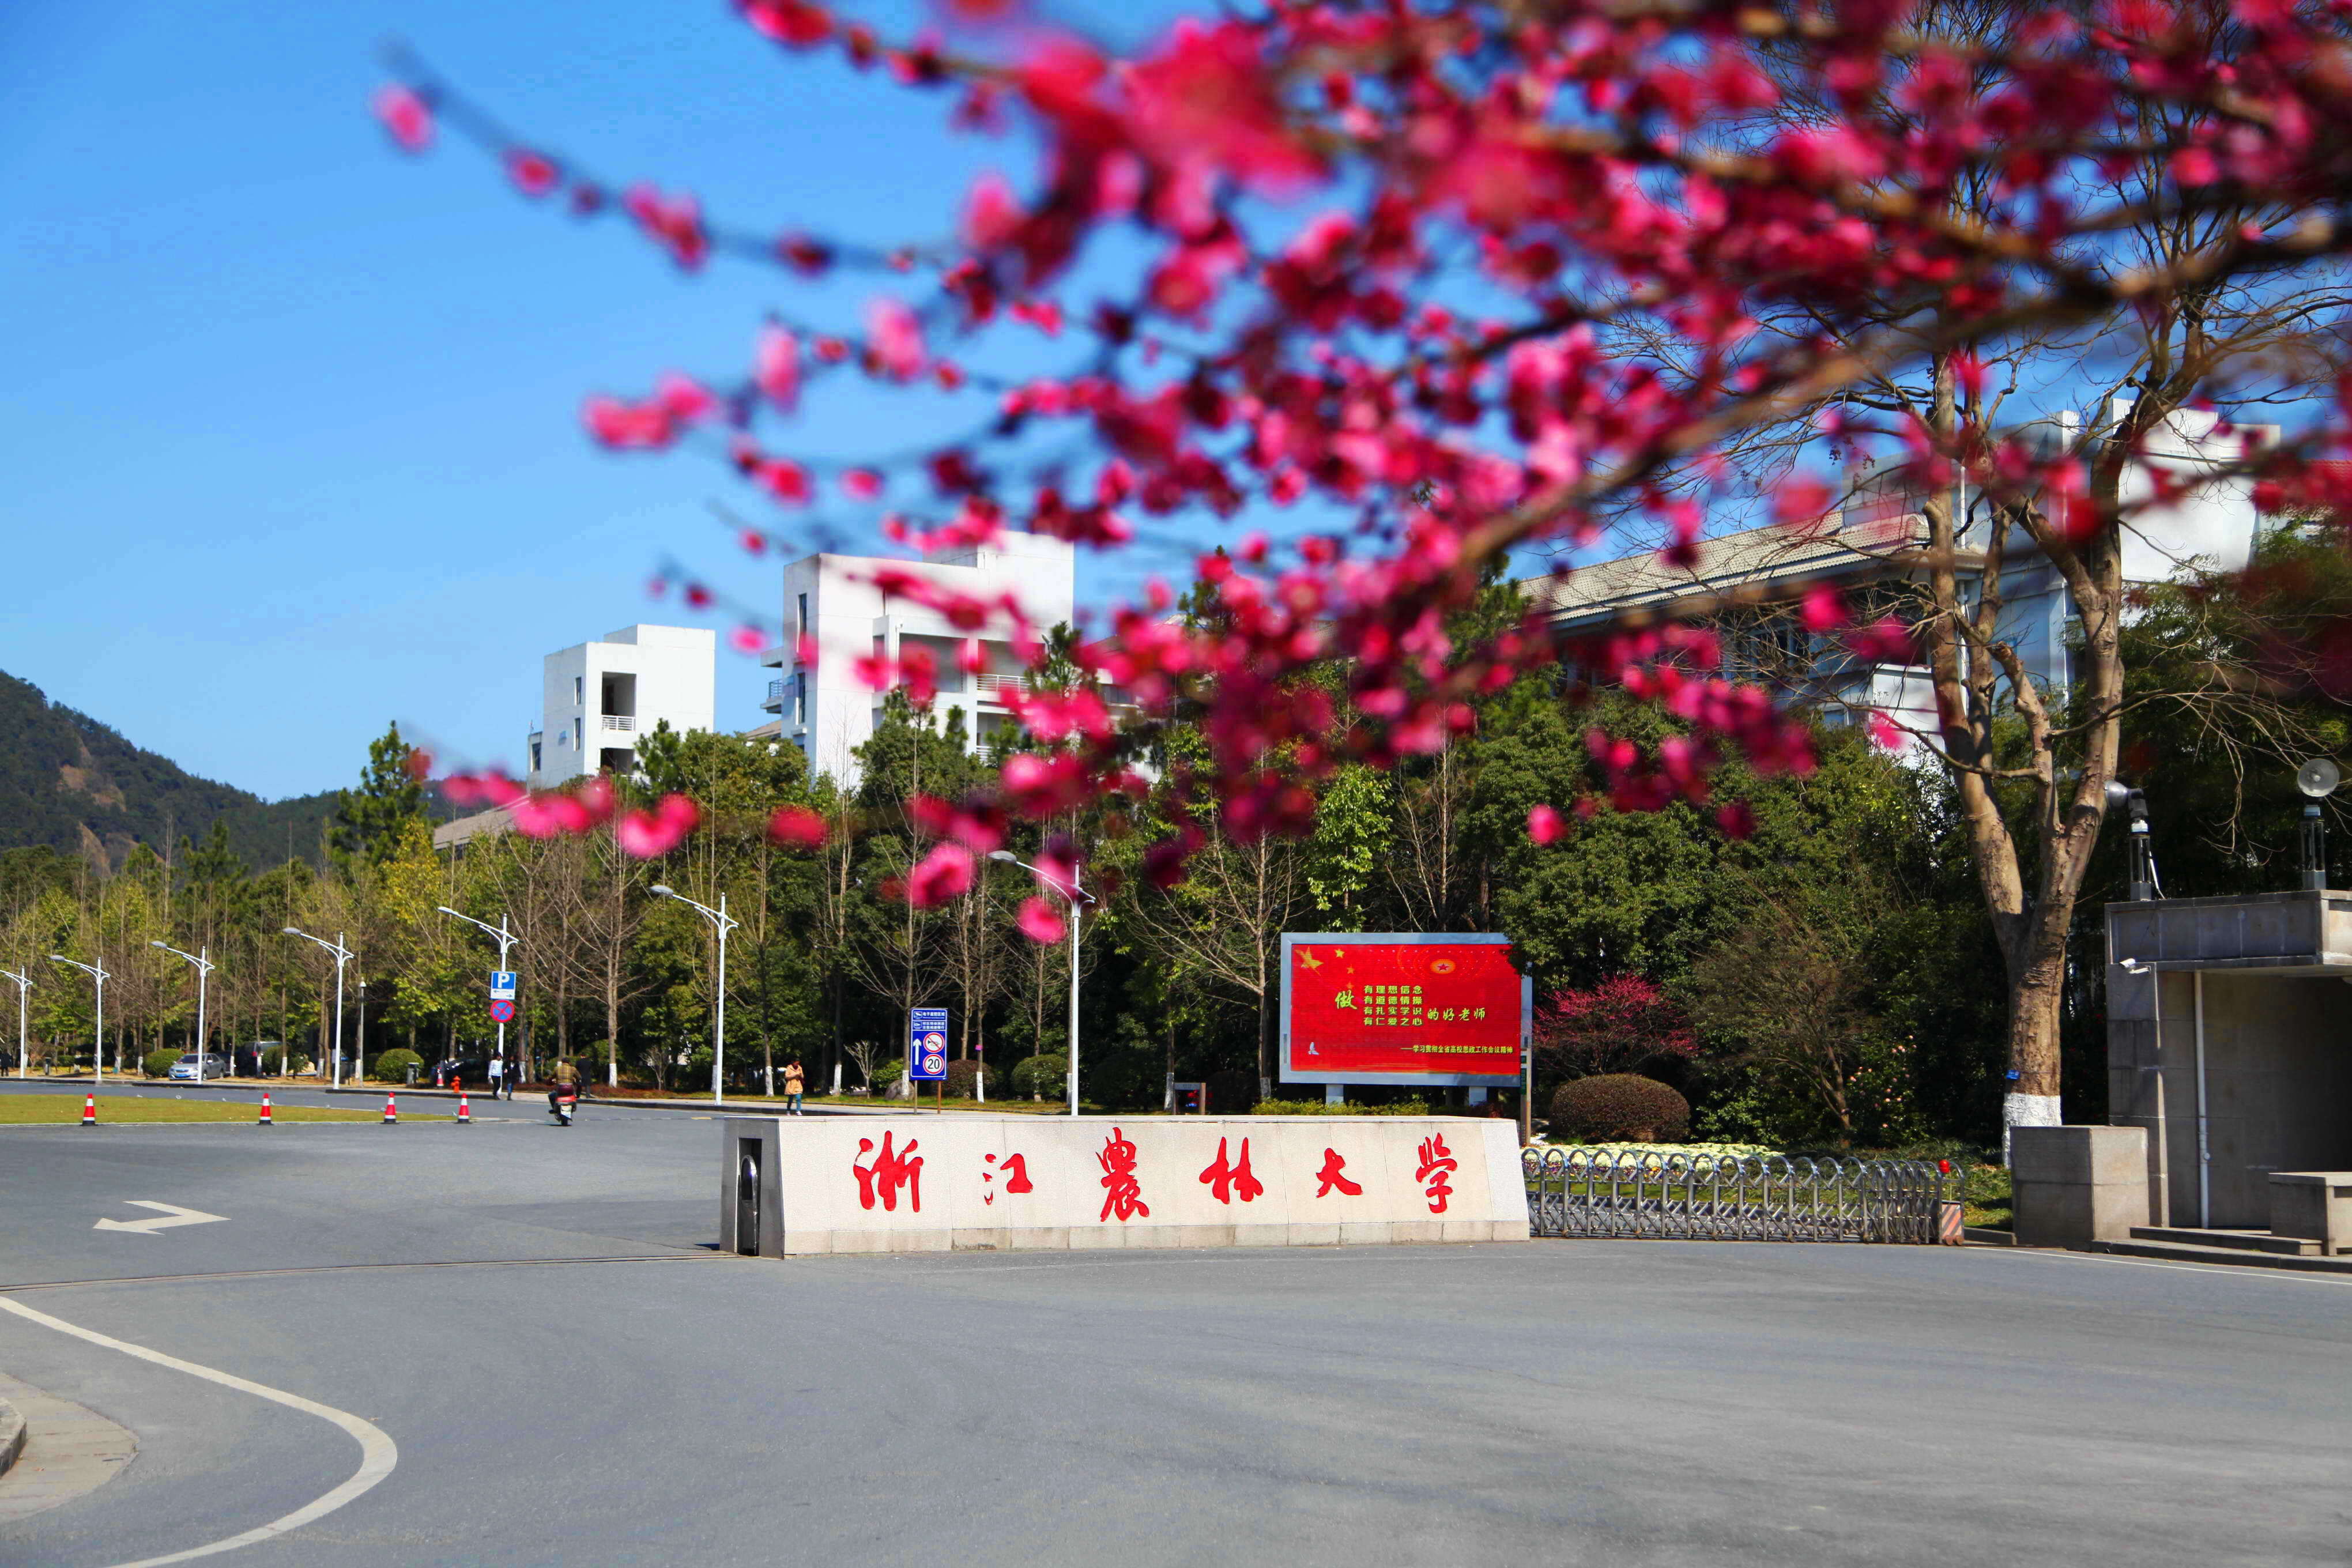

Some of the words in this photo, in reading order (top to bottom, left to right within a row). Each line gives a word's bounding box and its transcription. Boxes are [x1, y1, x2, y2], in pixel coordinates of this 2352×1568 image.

[497, 973, 510, 989] P
[1364, 985, 1422, 994] 有理想信念
[1335, 989, 1358, 1009] 做
[1364, 996, 1422, 1005] 有道德情操
[1364, 1007, 1422, 1015] 有扎实学识
[1427, 1007, 1486, 1022] 的好老师
[1364, 1017, 1423, 1026] 有仁爱之心
[928, 1058, 940, 1069] 20
